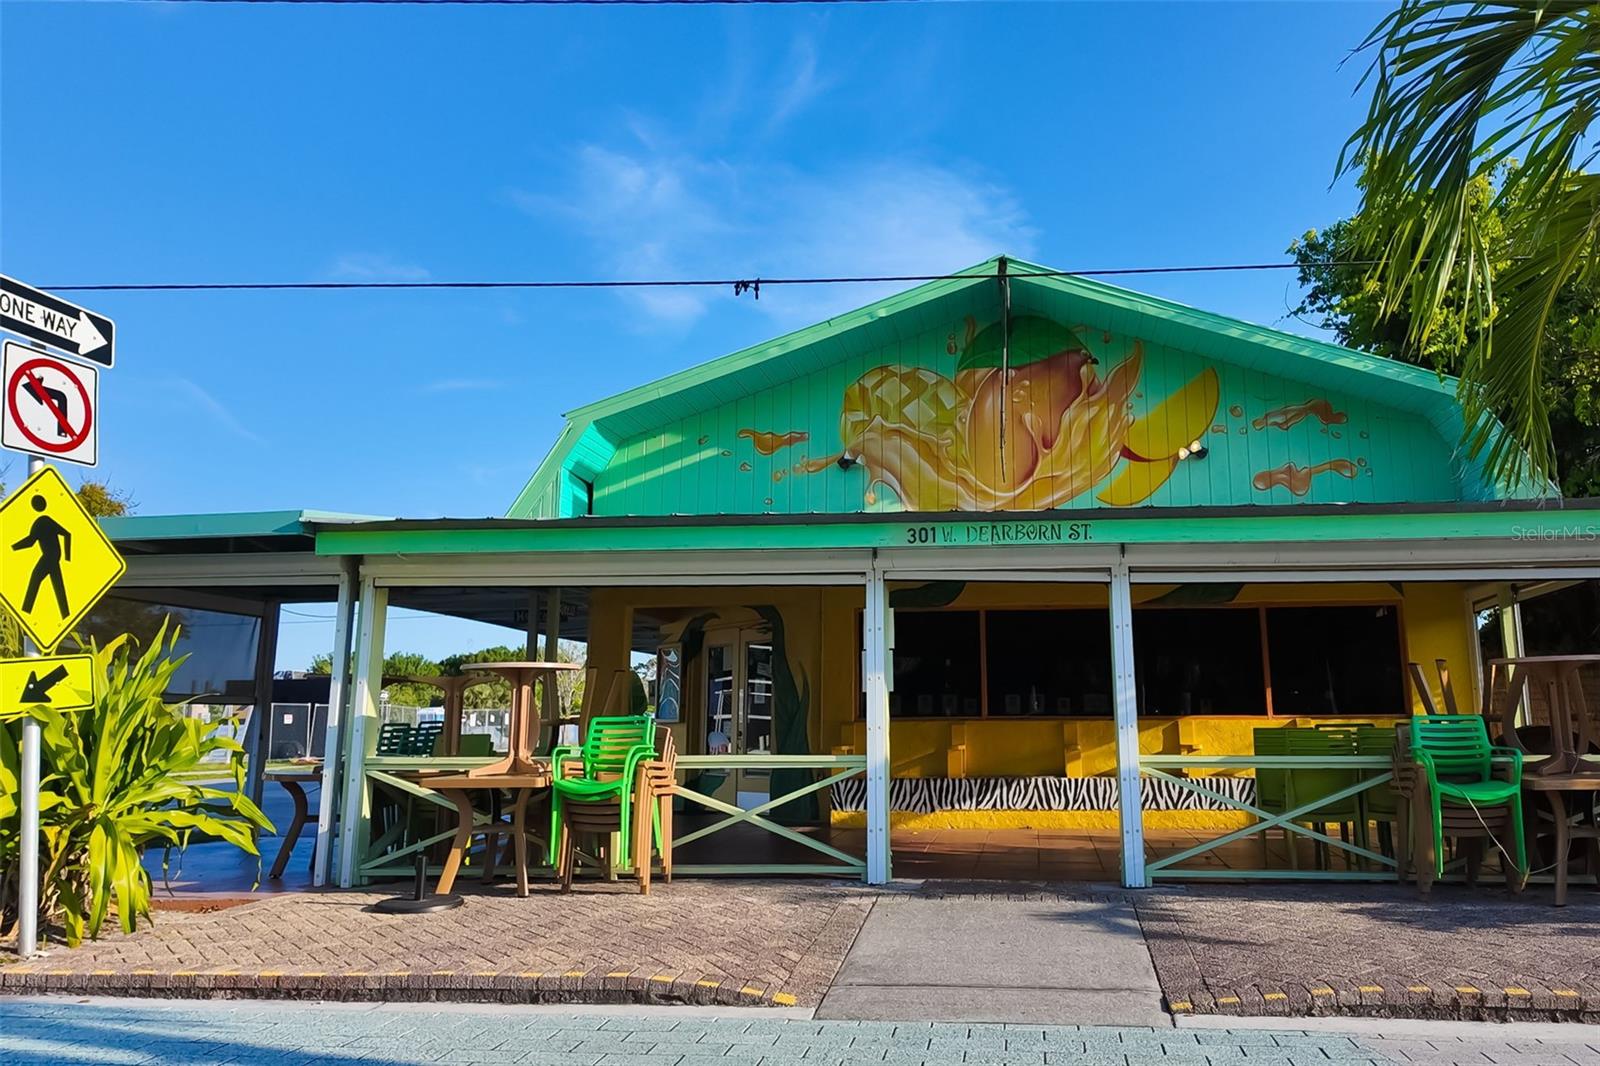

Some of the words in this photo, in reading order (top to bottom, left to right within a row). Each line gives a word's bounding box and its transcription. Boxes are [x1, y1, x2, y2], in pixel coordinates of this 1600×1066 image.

[0, 293, 36, 323] ONE
[42, 309, 77, 338] WAY
[907, 527, 937, 544] 301
[941, 527, 957, 543] W.
[966, 523, 1062, 543] DEARBORN
[1068, 523, 1093, 541] ST.
